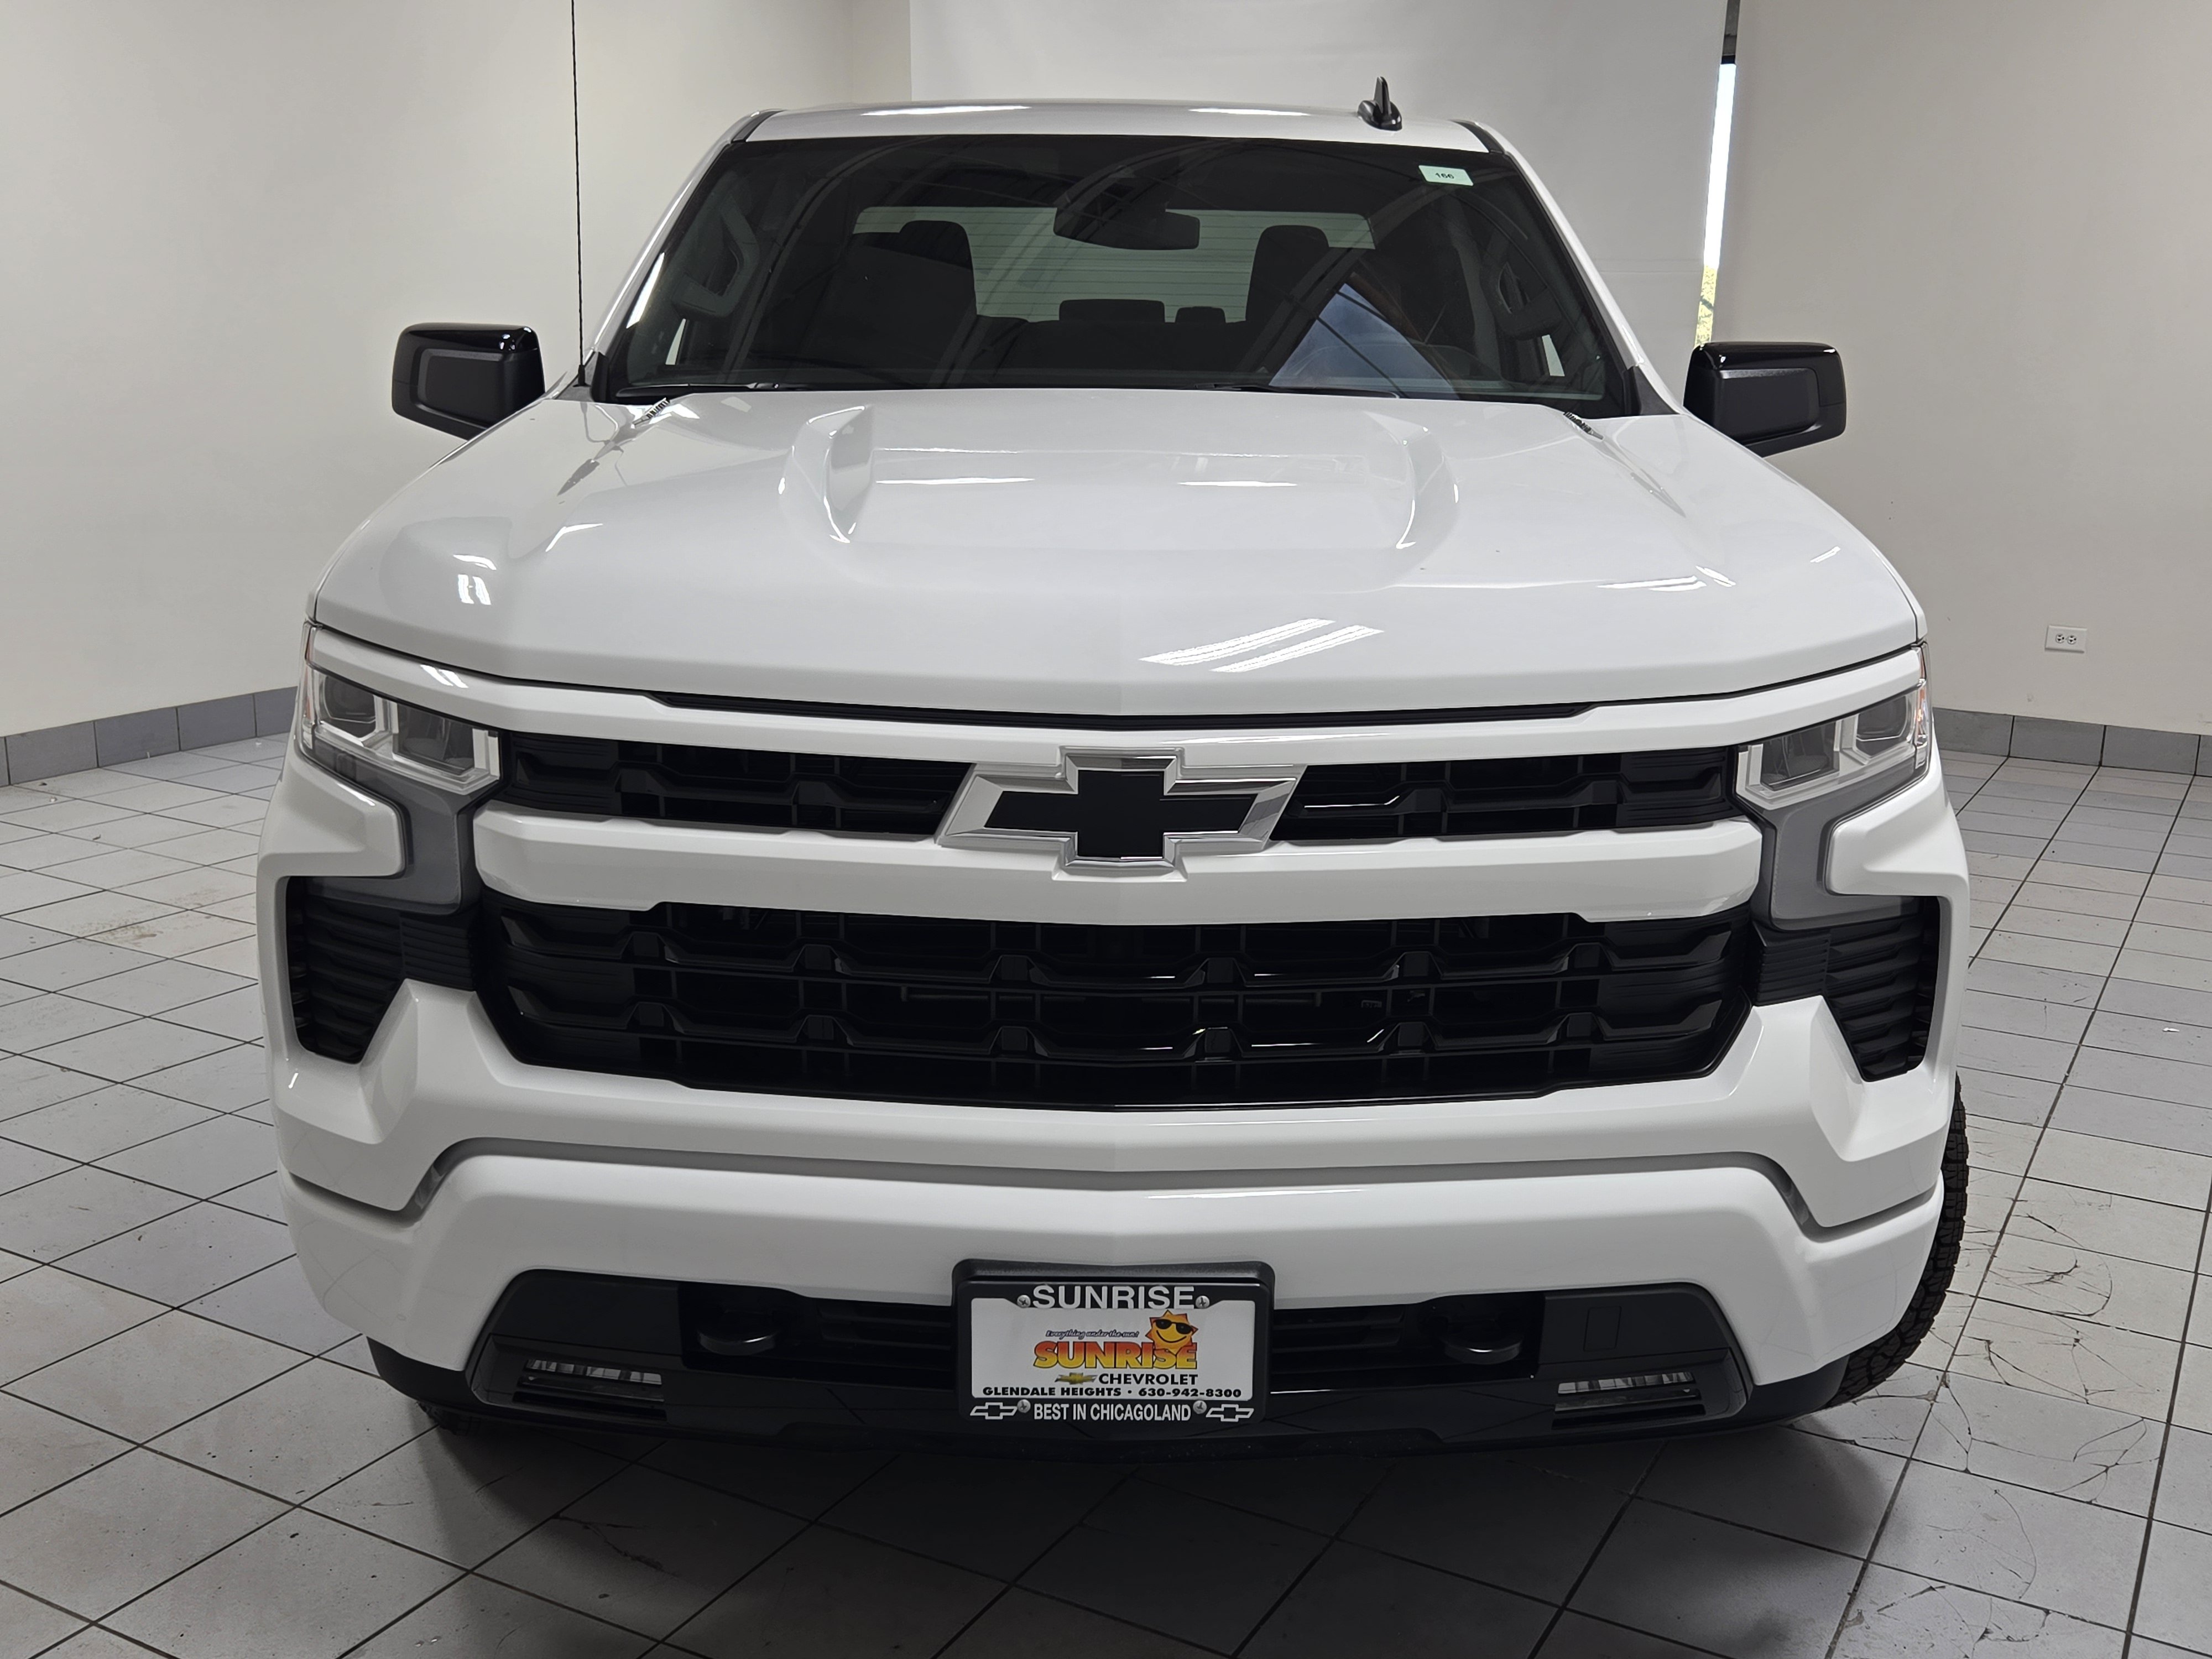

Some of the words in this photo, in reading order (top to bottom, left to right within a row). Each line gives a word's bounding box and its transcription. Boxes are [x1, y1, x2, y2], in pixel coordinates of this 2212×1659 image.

[1032, 1285, 1194, 1310] SUNRISE
[1046, 1329, 1086, 1339] Everything
[1033, 1340, 1198, 1369] SUNRISE
[1098, 1373, 1198, 1385] CHEVROLET
[983, 1386, 1056, 1396] GLENDALE
[1060, 1387, 1121, 1396] HEIGHTS
[1138, 1387, 1241, 1398] 630-942-8300
[1034, 1404, 1070, 1420] BEST
[1073, 1404, 1088, 1420] IN
[1090, 1404, 1191, 1421] CHICAGOLAND
